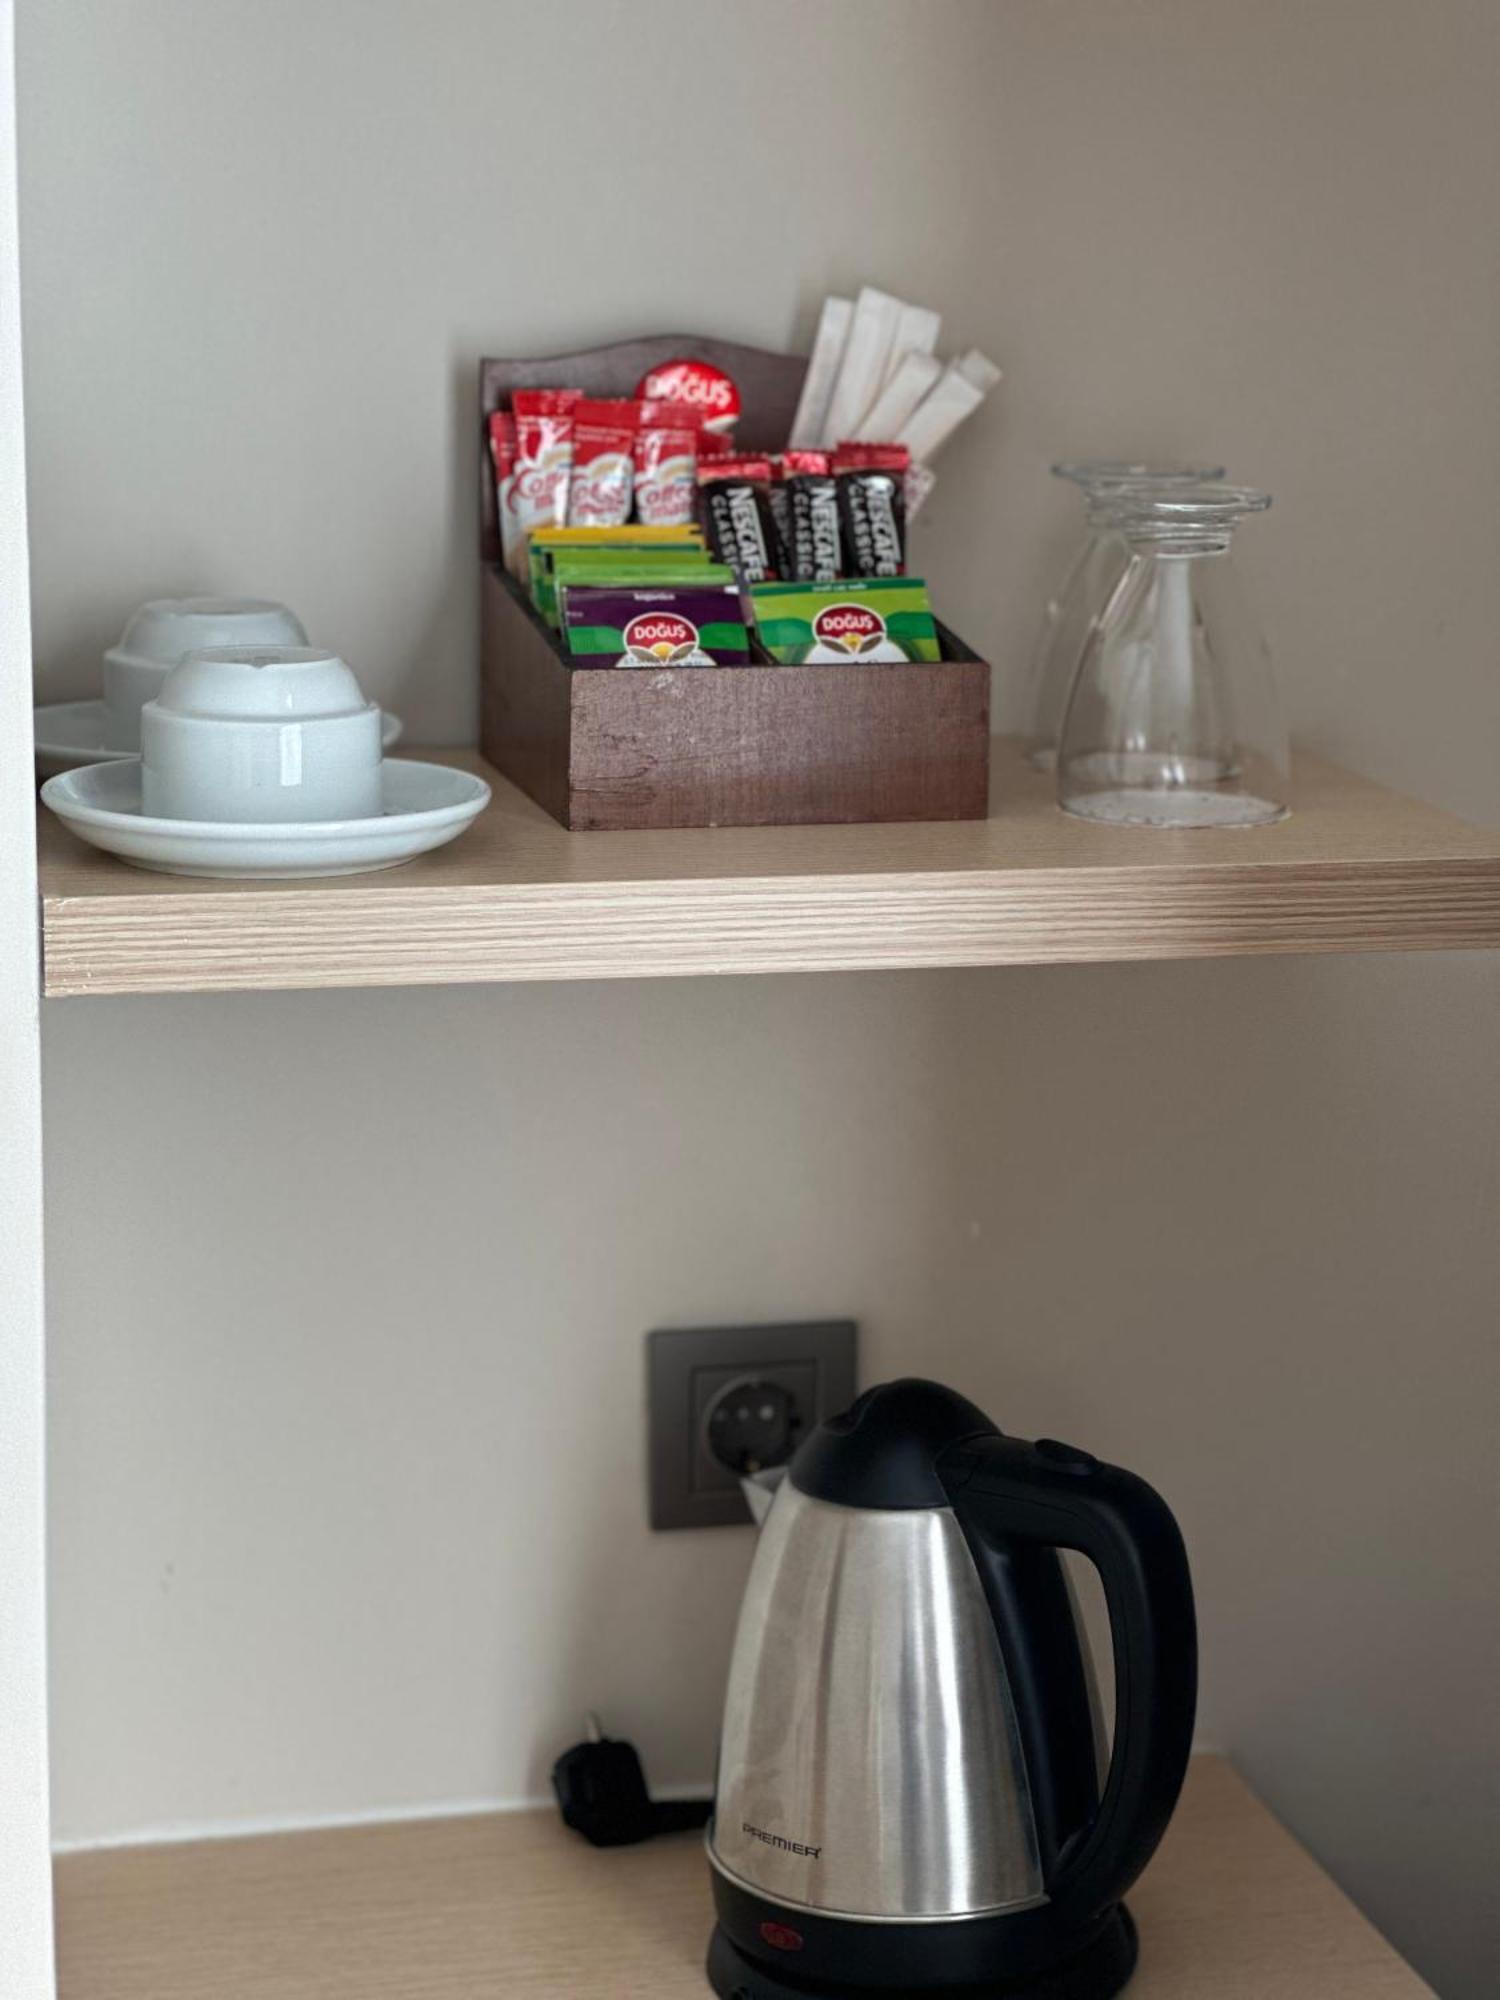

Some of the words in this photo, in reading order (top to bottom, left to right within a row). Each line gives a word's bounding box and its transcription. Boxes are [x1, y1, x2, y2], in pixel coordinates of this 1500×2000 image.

[794, 493, 813, 576] CLASSIC
[848, 484, 874, 569] CLASSIC
[634, 622, 687, 639] DOĞUŞ
[742, 1823, 822, 1859] PREMIER
